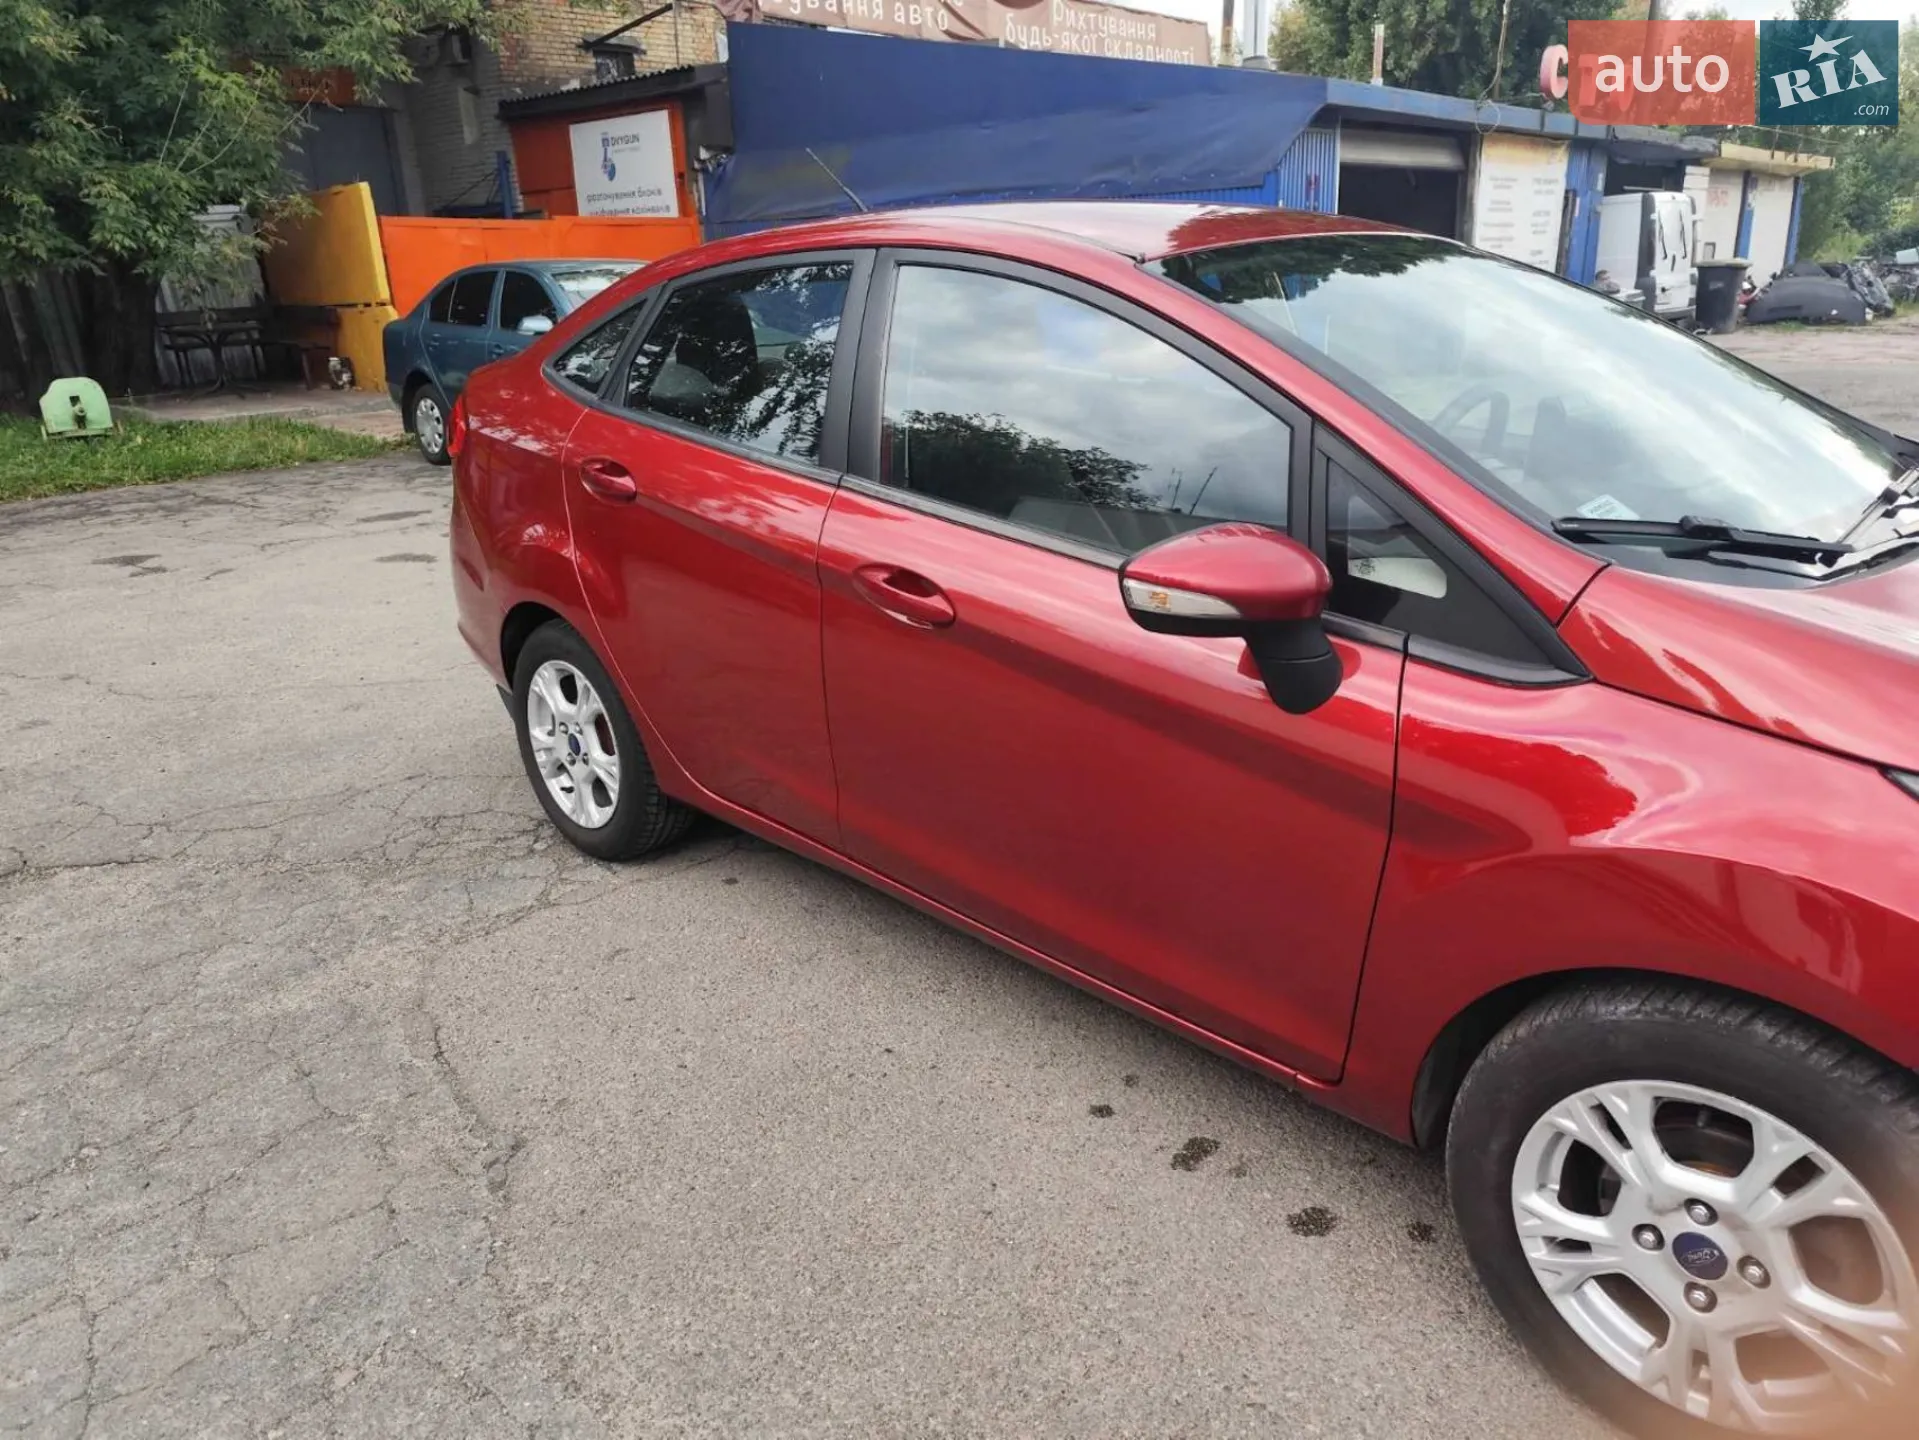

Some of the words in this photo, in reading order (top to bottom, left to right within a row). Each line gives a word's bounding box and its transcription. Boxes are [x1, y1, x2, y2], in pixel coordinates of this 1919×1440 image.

[894, 4, 948, 30] авто
[1006, 12, 1098, 54] будь-якої
[1053, 0, 1156, 40] Рихтування
